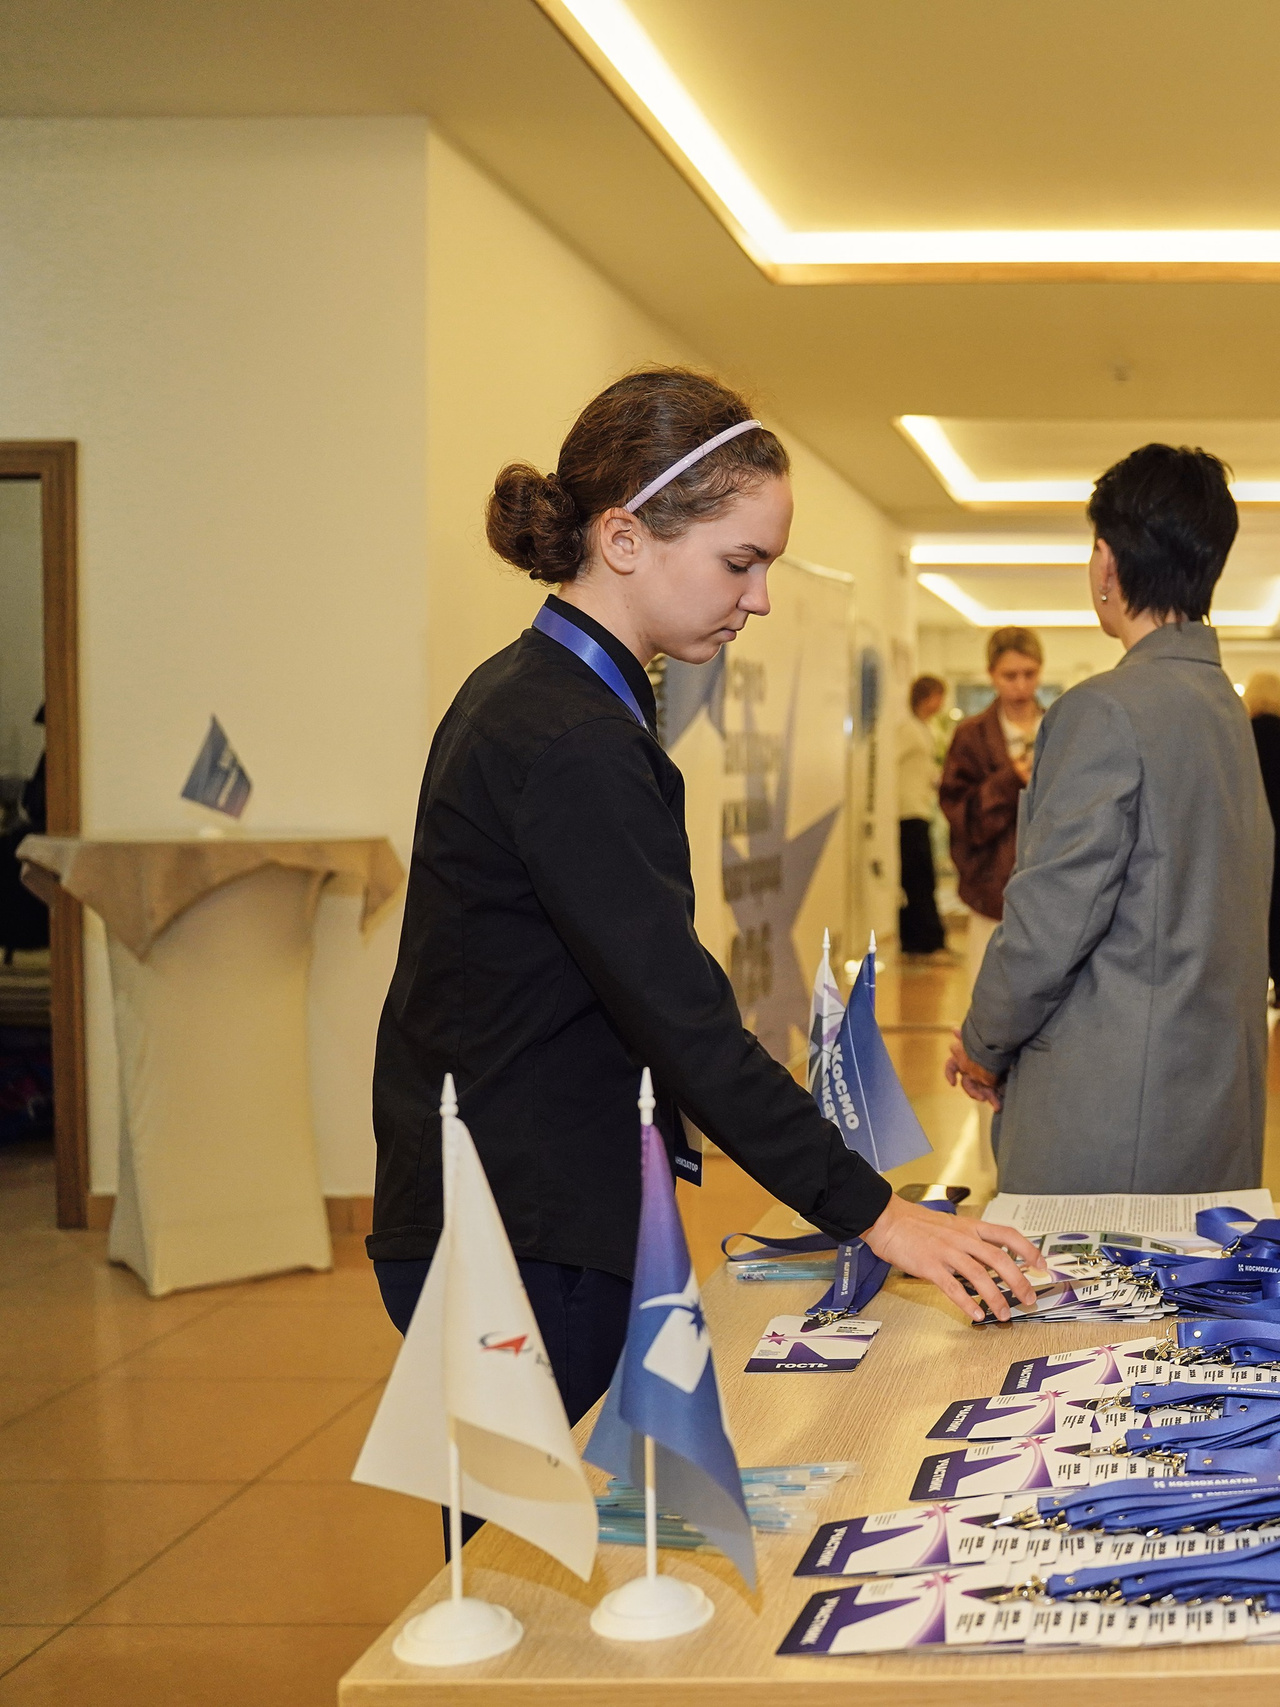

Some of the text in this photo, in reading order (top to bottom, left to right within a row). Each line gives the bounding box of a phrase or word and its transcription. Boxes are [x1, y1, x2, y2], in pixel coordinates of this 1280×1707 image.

[831, 1043, 860, 1130] Космо
[1016, 1363, 1034, 1390] УЧАСТНИК
[945, 1404, 974, 1433] УЧАСТНИК
[928, 1458, 950, 1492] УЧАСТНИК
[1168, 1477, 1257, 1488] КОСМОХАКАТОН
[816, 1526, 848, 1567] УЧАСТНИК
[800, 1596, 841, 1646] УЧАСТНИК
